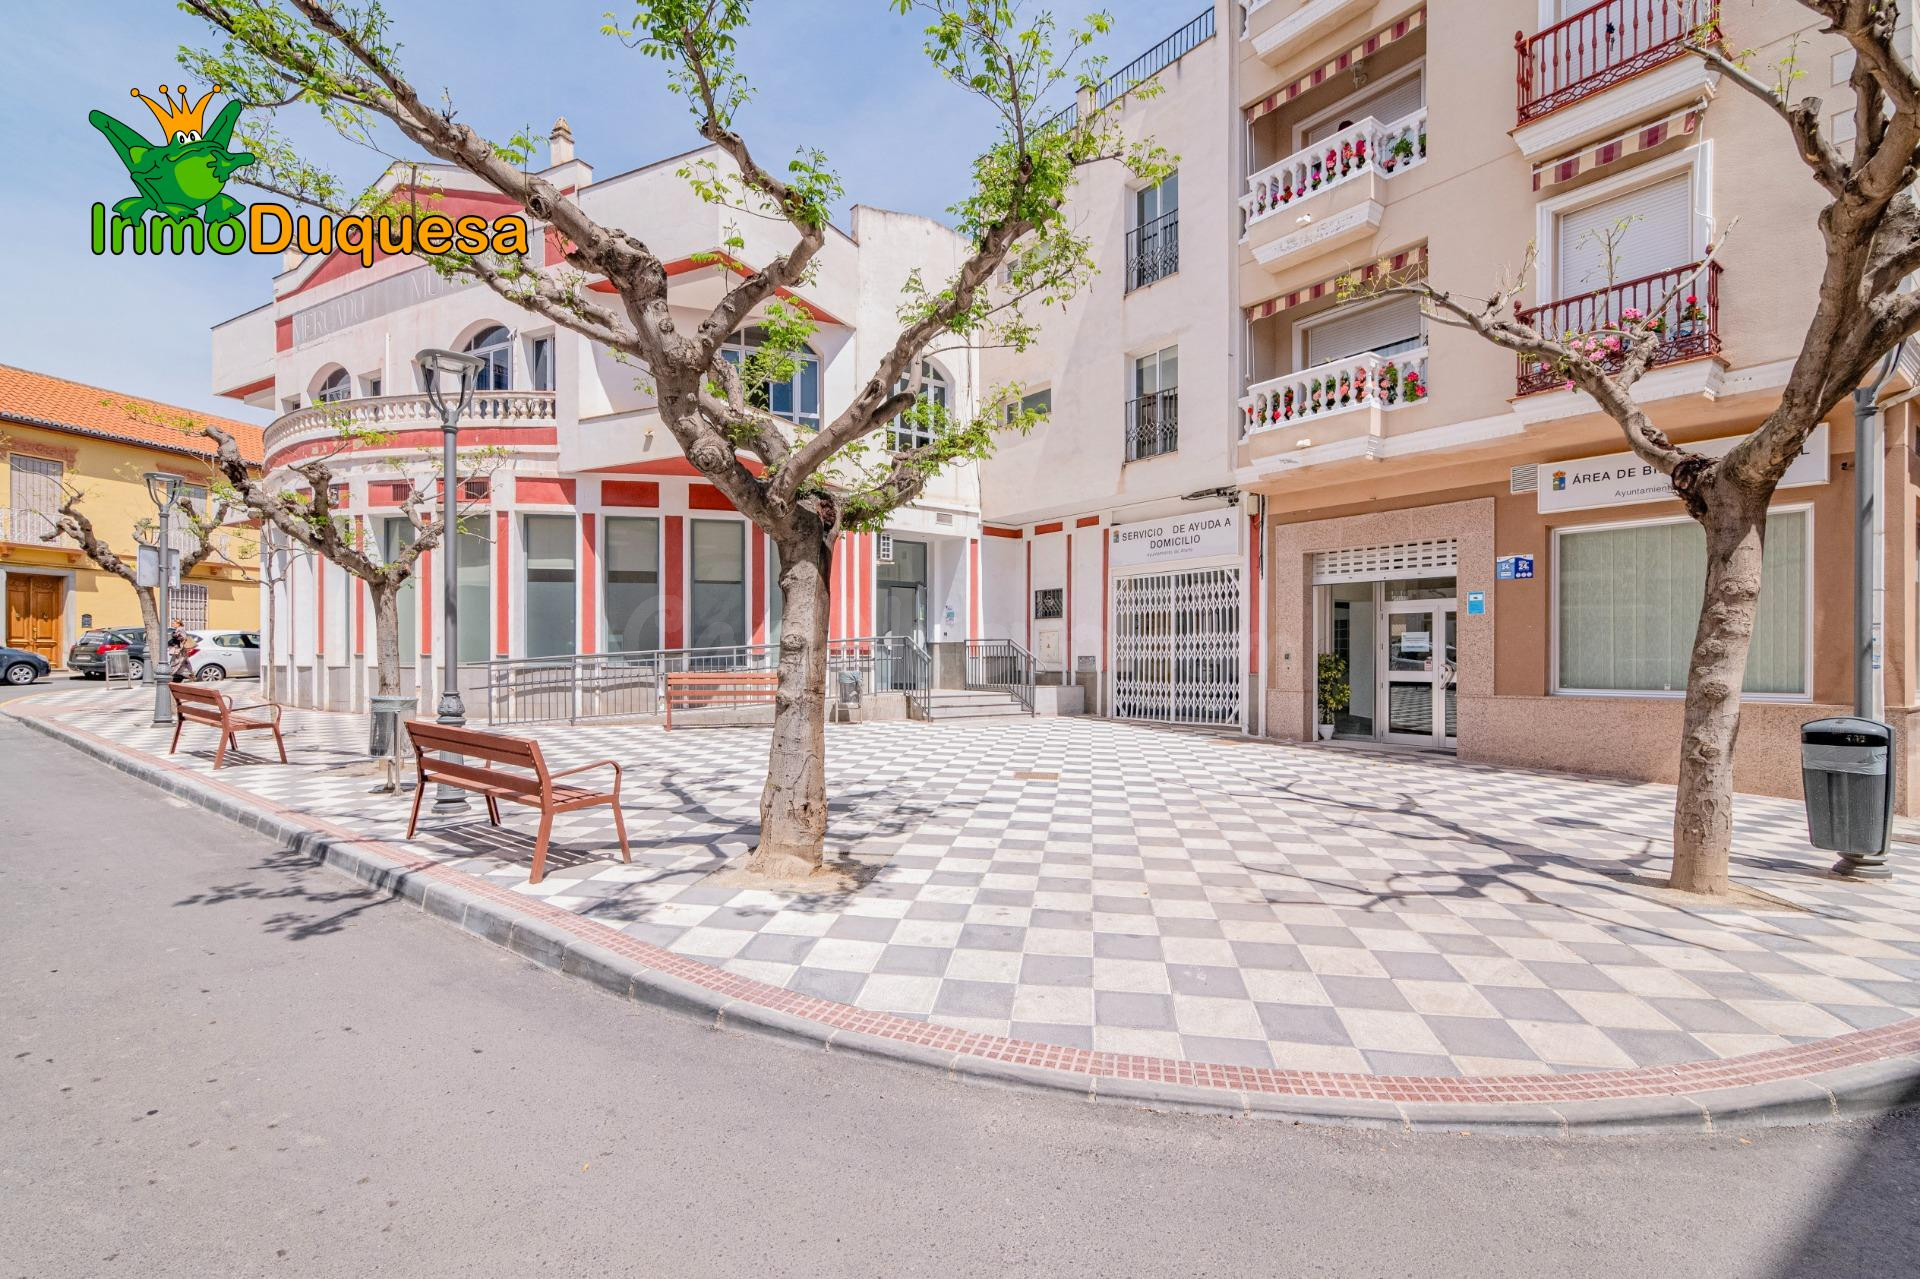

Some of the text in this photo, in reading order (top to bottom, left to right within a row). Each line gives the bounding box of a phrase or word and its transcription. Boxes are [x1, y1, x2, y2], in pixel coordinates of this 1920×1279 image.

[1572, 471, 1611, 485] ÁREA
[1617, 468, 1636, 479] DE
[1614, 485, 1673, 498] Ayuntamient
[1122, 518, 1231, 541] SERVICIO DE AYUDA A
[1150, 535, 1201, 549] DOMICILIO
